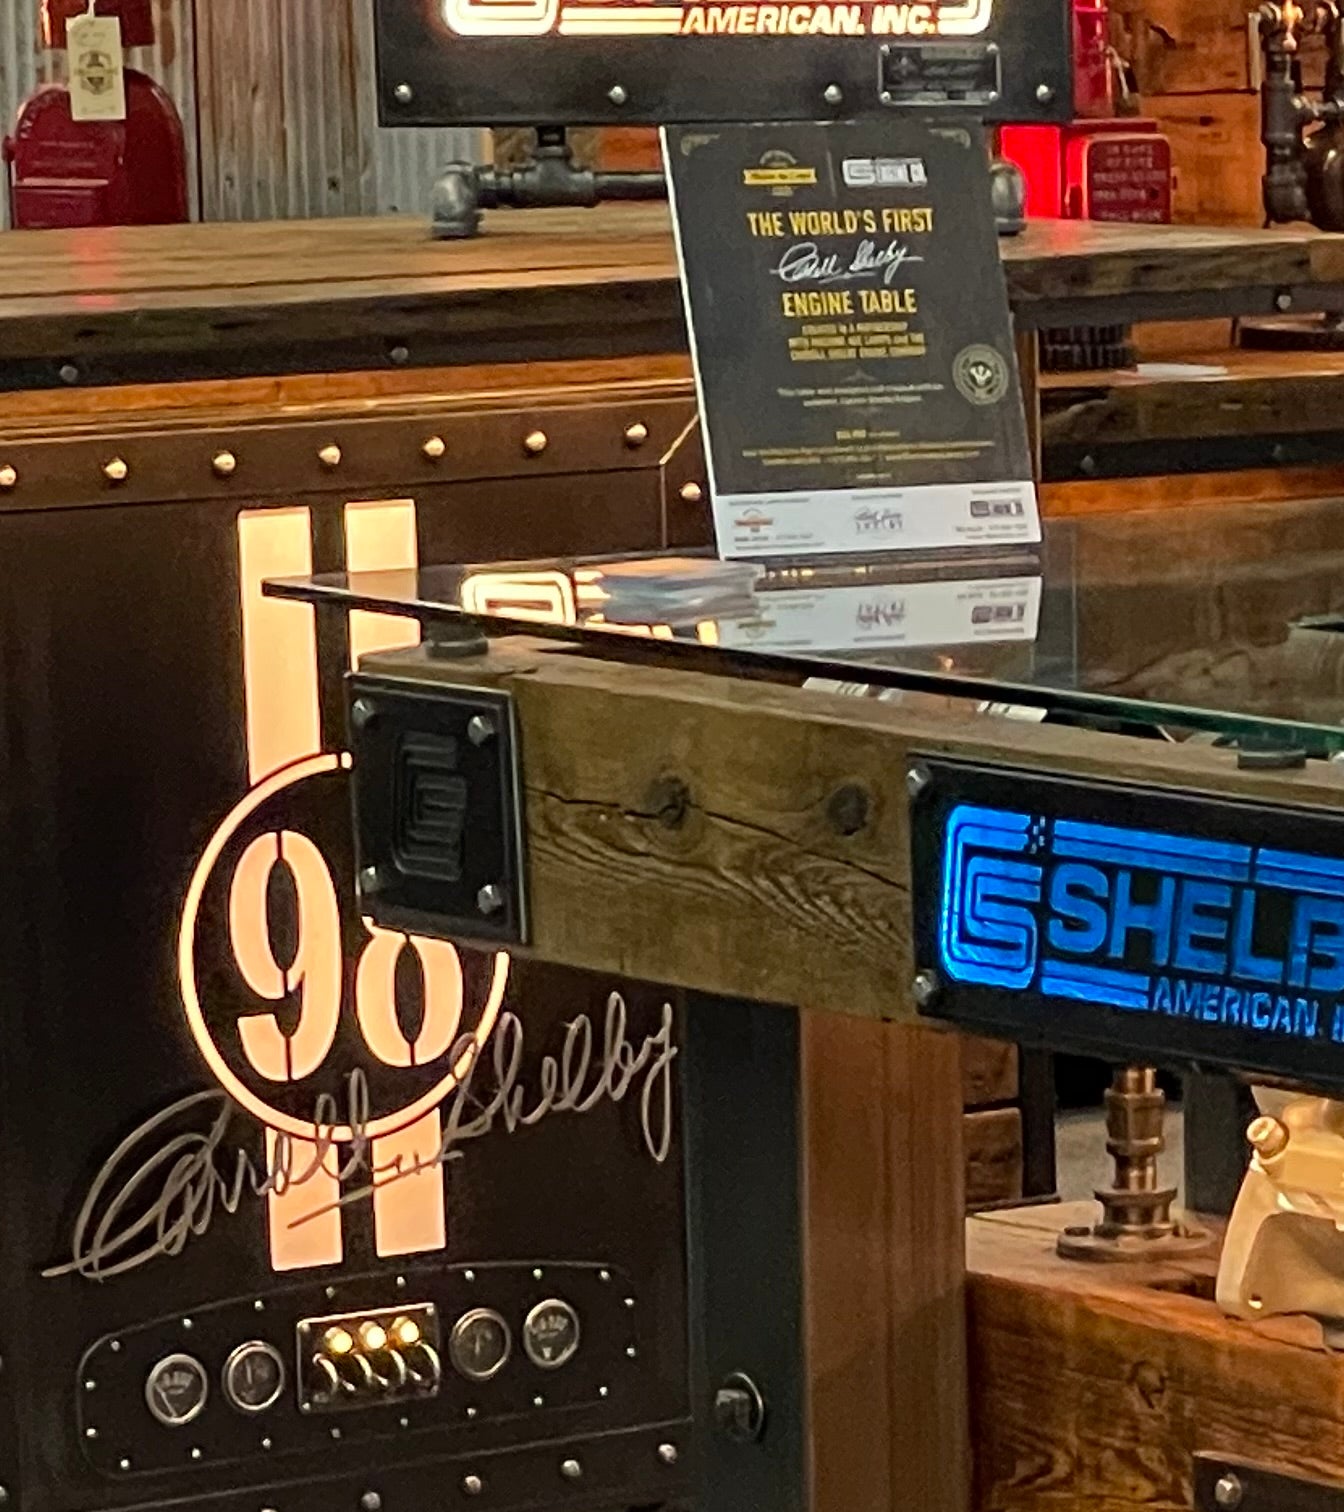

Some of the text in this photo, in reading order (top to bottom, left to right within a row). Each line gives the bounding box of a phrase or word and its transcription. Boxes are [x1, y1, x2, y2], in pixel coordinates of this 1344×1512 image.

[748, 207, 933, 237] THE WORLD'S FIRST
[782, 288, 918, 318] ENGINE TABLE
